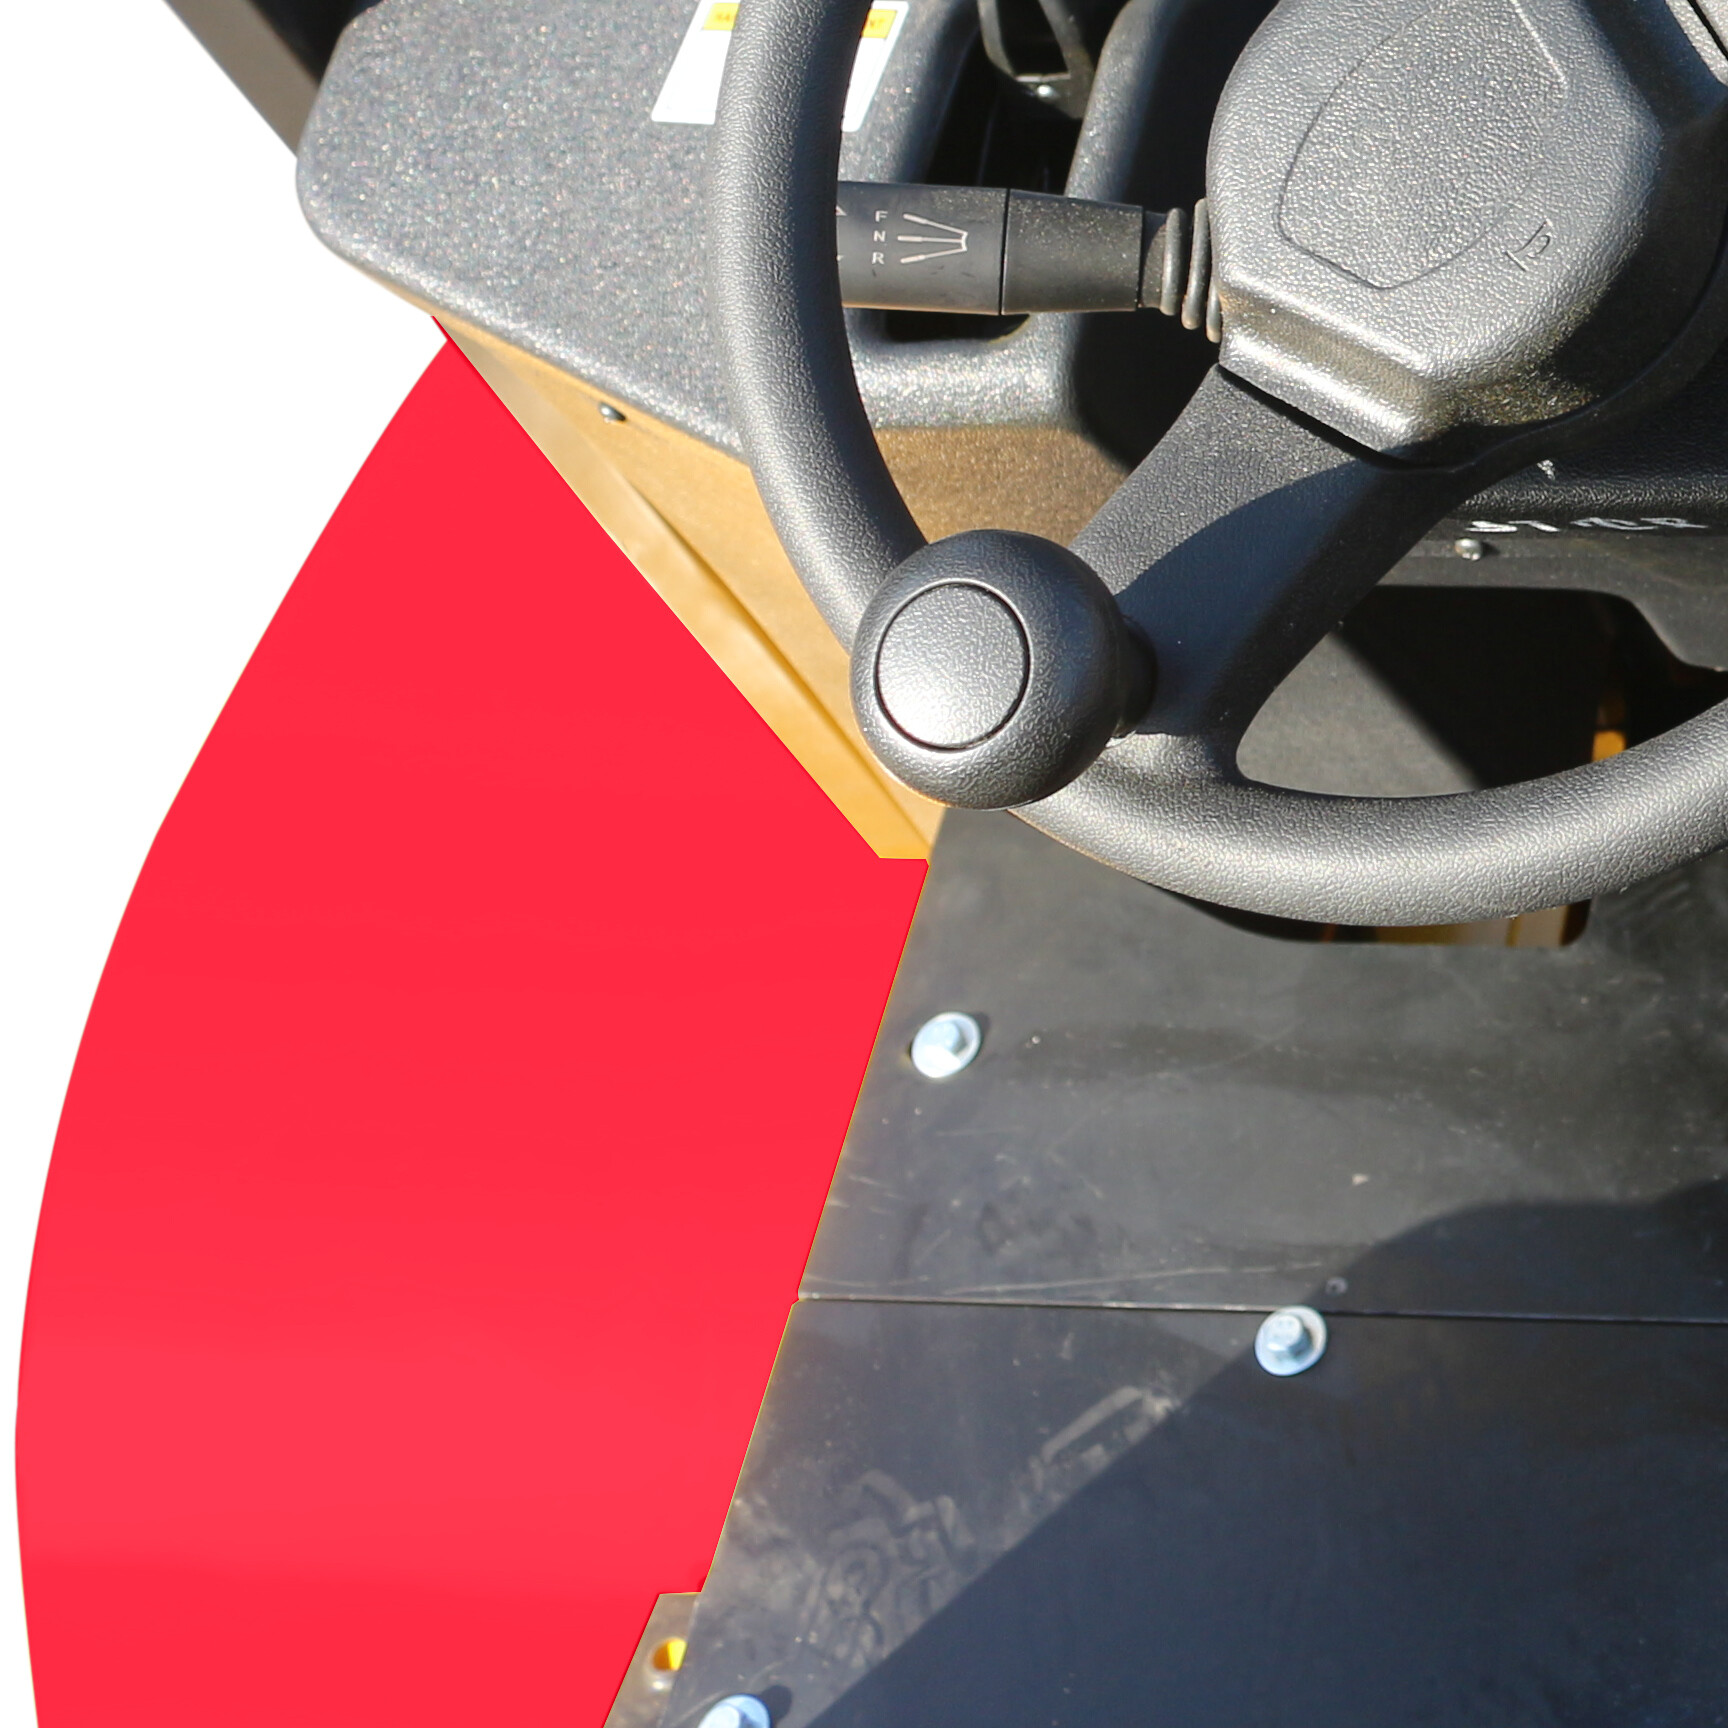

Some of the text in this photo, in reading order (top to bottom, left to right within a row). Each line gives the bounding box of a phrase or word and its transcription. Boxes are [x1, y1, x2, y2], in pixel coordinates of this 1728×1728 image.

[875, 210, 888, 222] F
[873, 230, 886, 242] N
[871, 251, 885, 265] R
